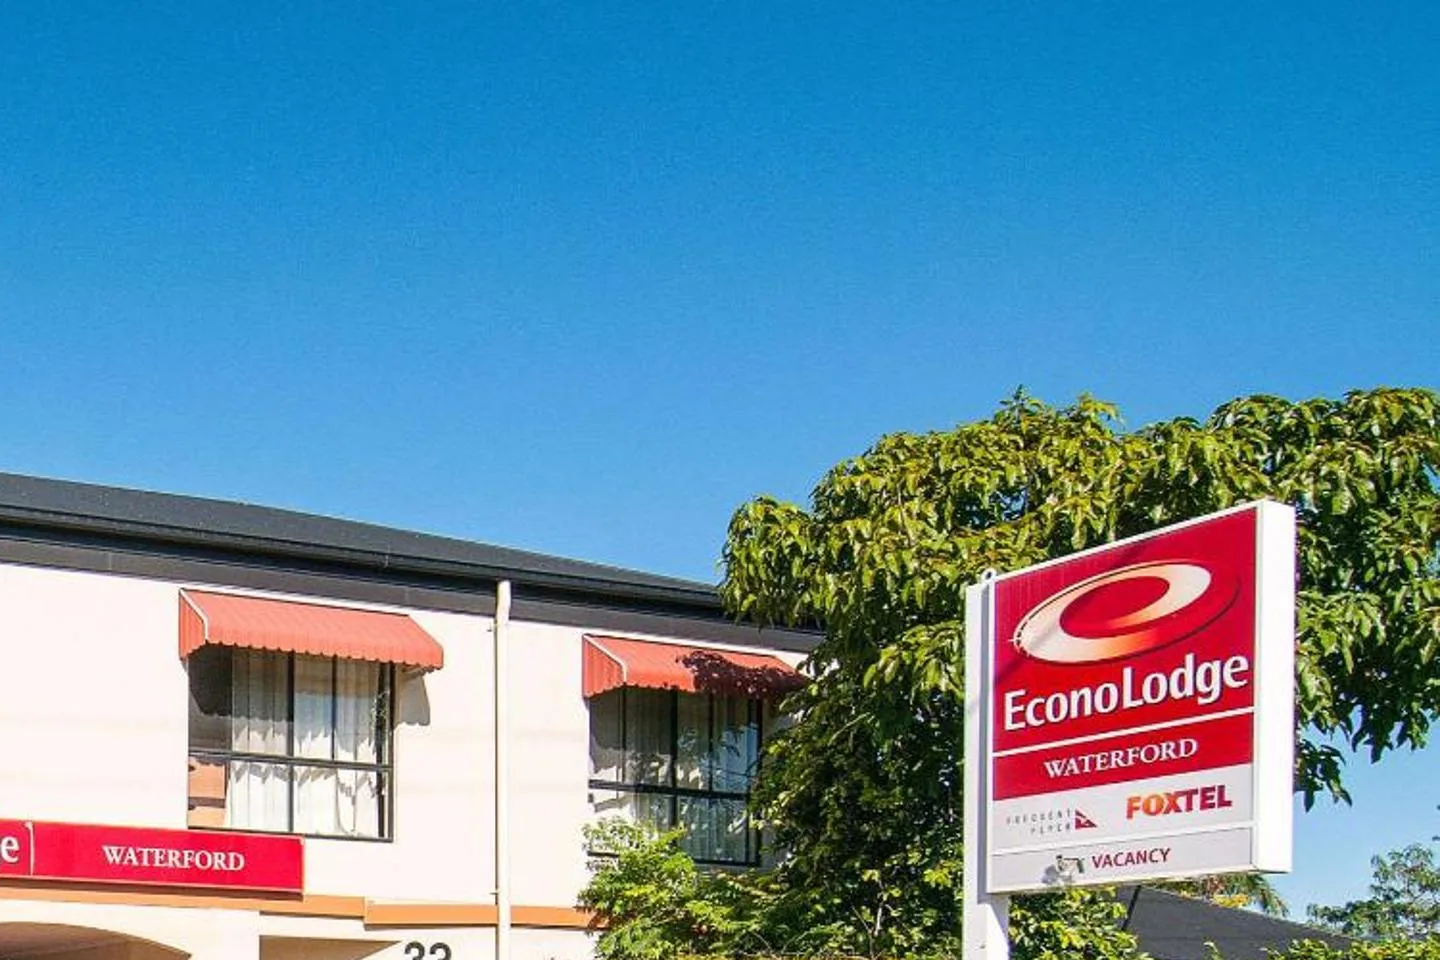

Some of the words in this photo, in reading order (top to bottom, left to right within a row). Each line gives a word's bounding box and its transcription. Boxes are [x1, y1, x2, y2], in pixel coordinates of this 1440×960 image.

[1003, 653, 1249, 733] EconoLodge
[1044, 737, 1198, 779] WATERFORD
[1125, 784, 1233, 820] FOXTEL
[103, 845, 245, 871] WATERFORD
[1092, 847, 1171, 869] VACANCY
